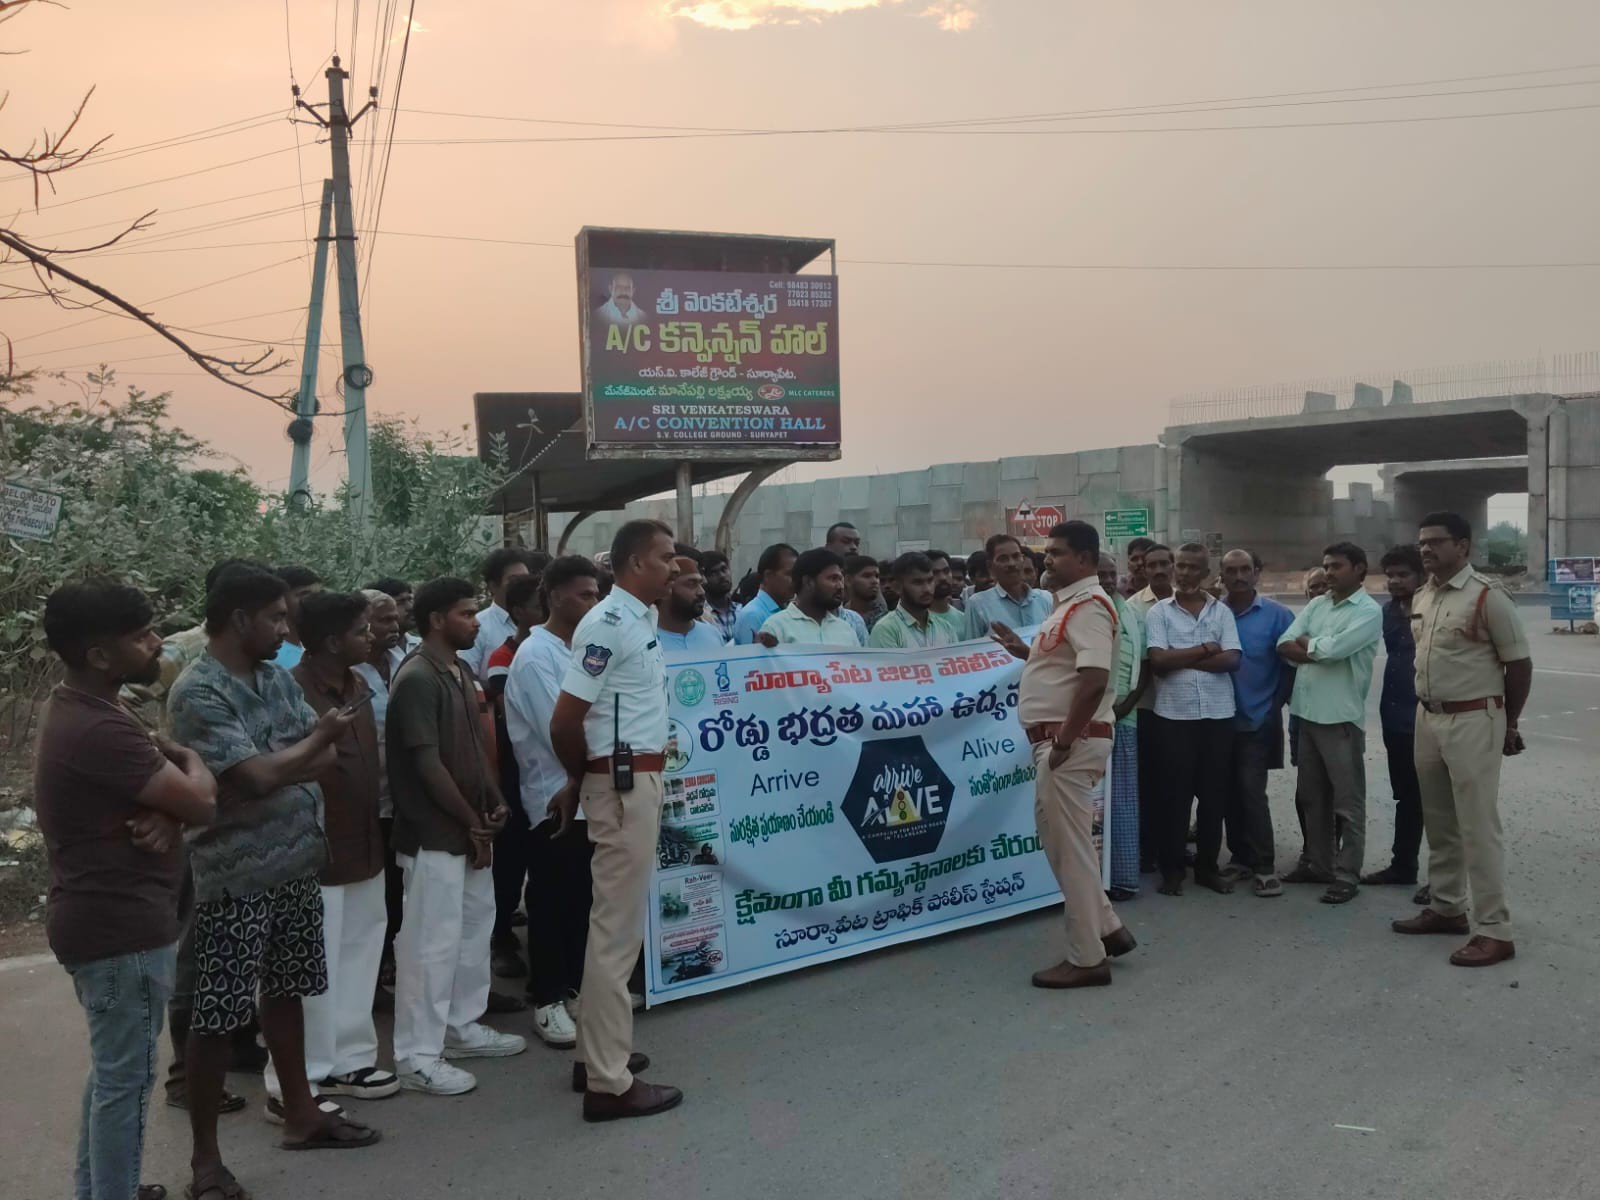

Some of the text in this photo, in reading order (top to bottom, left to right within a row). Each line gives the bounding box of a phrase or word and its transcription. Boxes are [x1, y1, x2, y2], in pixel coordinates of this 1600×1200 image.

[656, 288, 777, 319] శ్రీ వెంకటేశ్వర
[606, 320, 828, 365] A/C కన్వెన్షన్ హాల్
[613, 416, 827, 431] A/C CONVENTION HALL
[652, 405, 790, 416] SRI VENKATESWARA
[673, 431, 708, 439] COLLEGE
[710, 431, 742, 439] GROUND
[750, 431, 788, 439] SURYAPET
[744, 661, 873, 694] సూర్యాపేట
[877, 663, 934, 685] జిల్లా
[698, 709, 770, 761] రోడ్డు
[777, 702, 864, 746] భద్రత
[870, 695, 944, 731] మహా
[961, 737, 1016, 762] Alive
[751, 769, 820, 797] Arrive
[873, 763, 922, 795] arrive
[797, 800, 834, 829] చేయండి
[735, 886, 824, 925] క్షేమంగా
[827, 874, 853, 902] మీ
[856, 844, 987, 897] గమ్యస్థానాలకు
[773, 872, 1026, 950] సూర్యాపేట ట్రాఫిక్ పోలీస్ స్టేషన్
